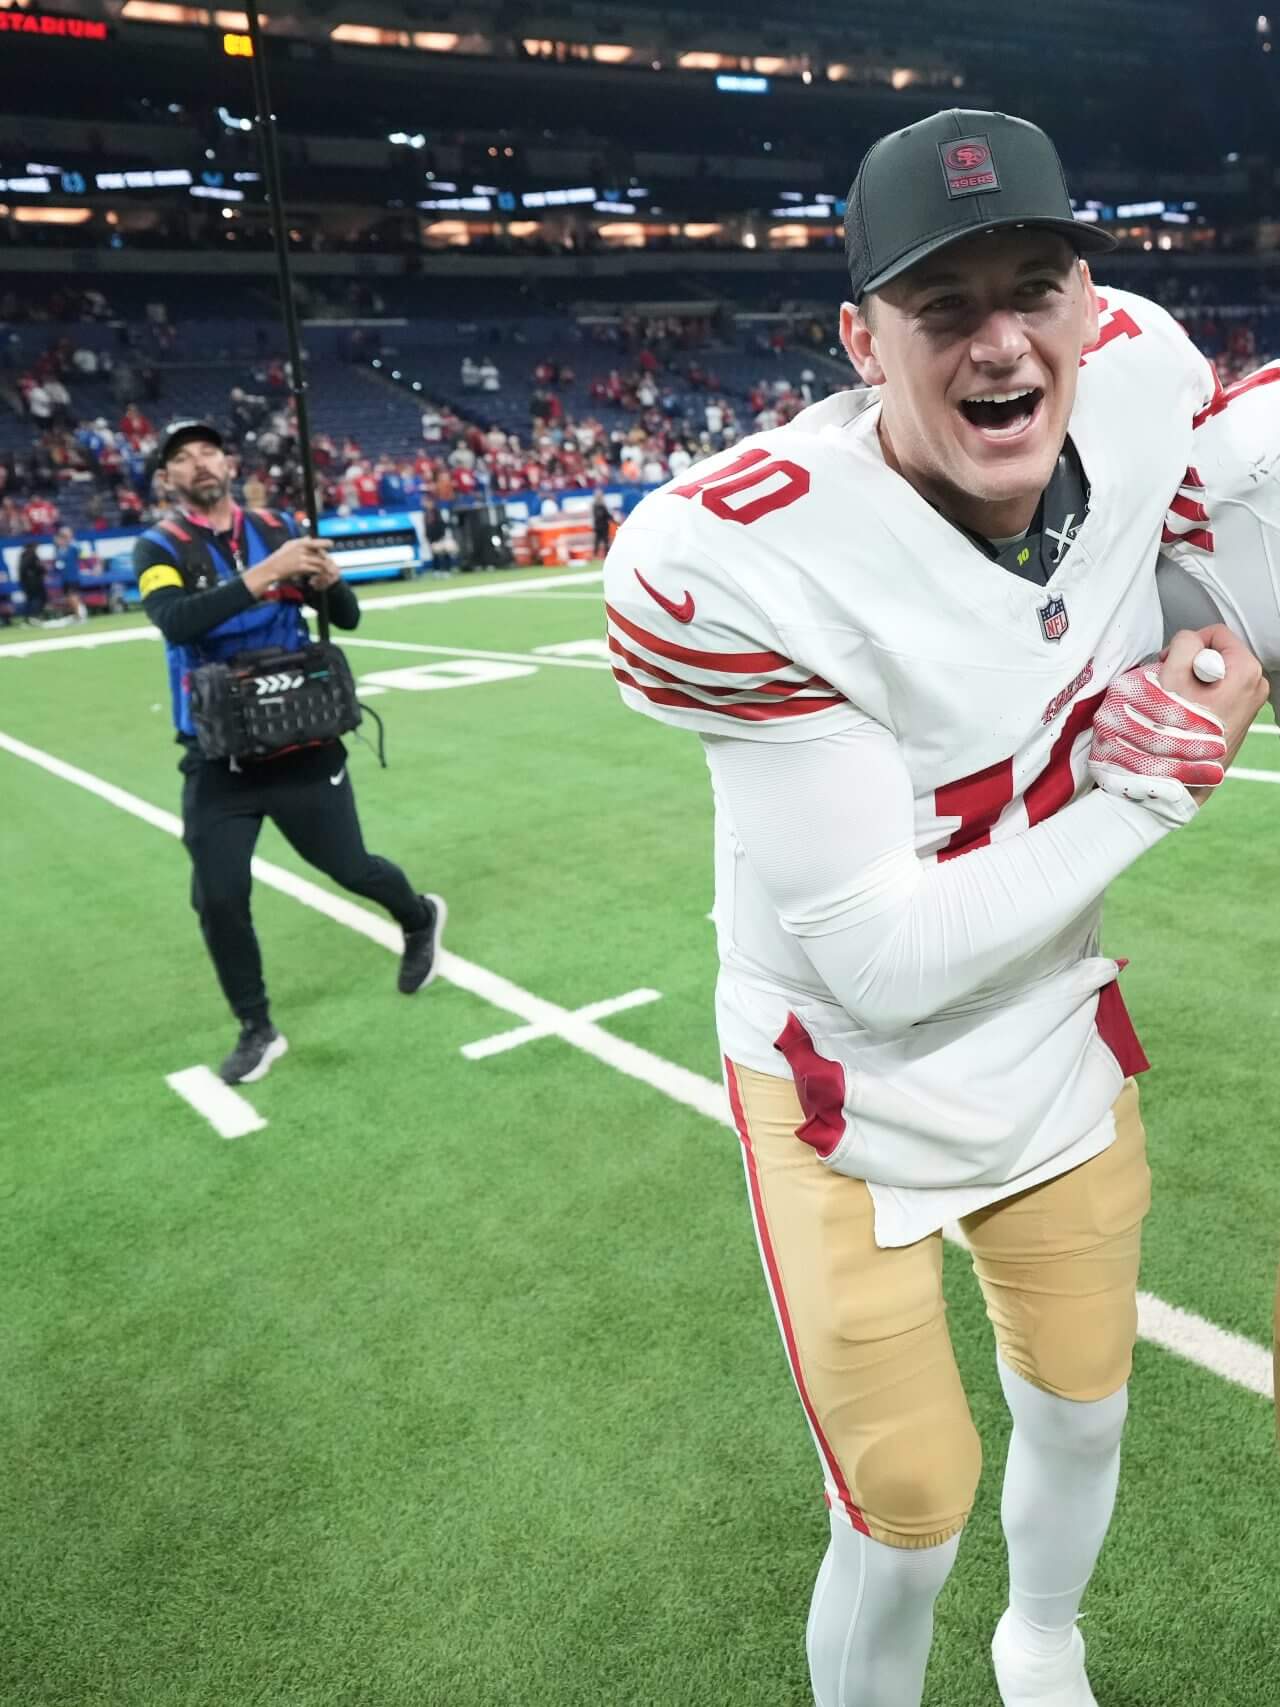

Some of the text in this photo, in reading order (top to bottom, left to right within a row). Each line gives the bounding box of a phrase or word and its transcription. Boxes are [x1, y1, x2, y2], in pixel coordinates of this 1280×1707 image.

[951, 174, 994, 189] 49ERS
[667, 448, 810, 526] 10
[1016, 547, 1030, 566] 10
[1045, 615, 1066, 637] NFL
